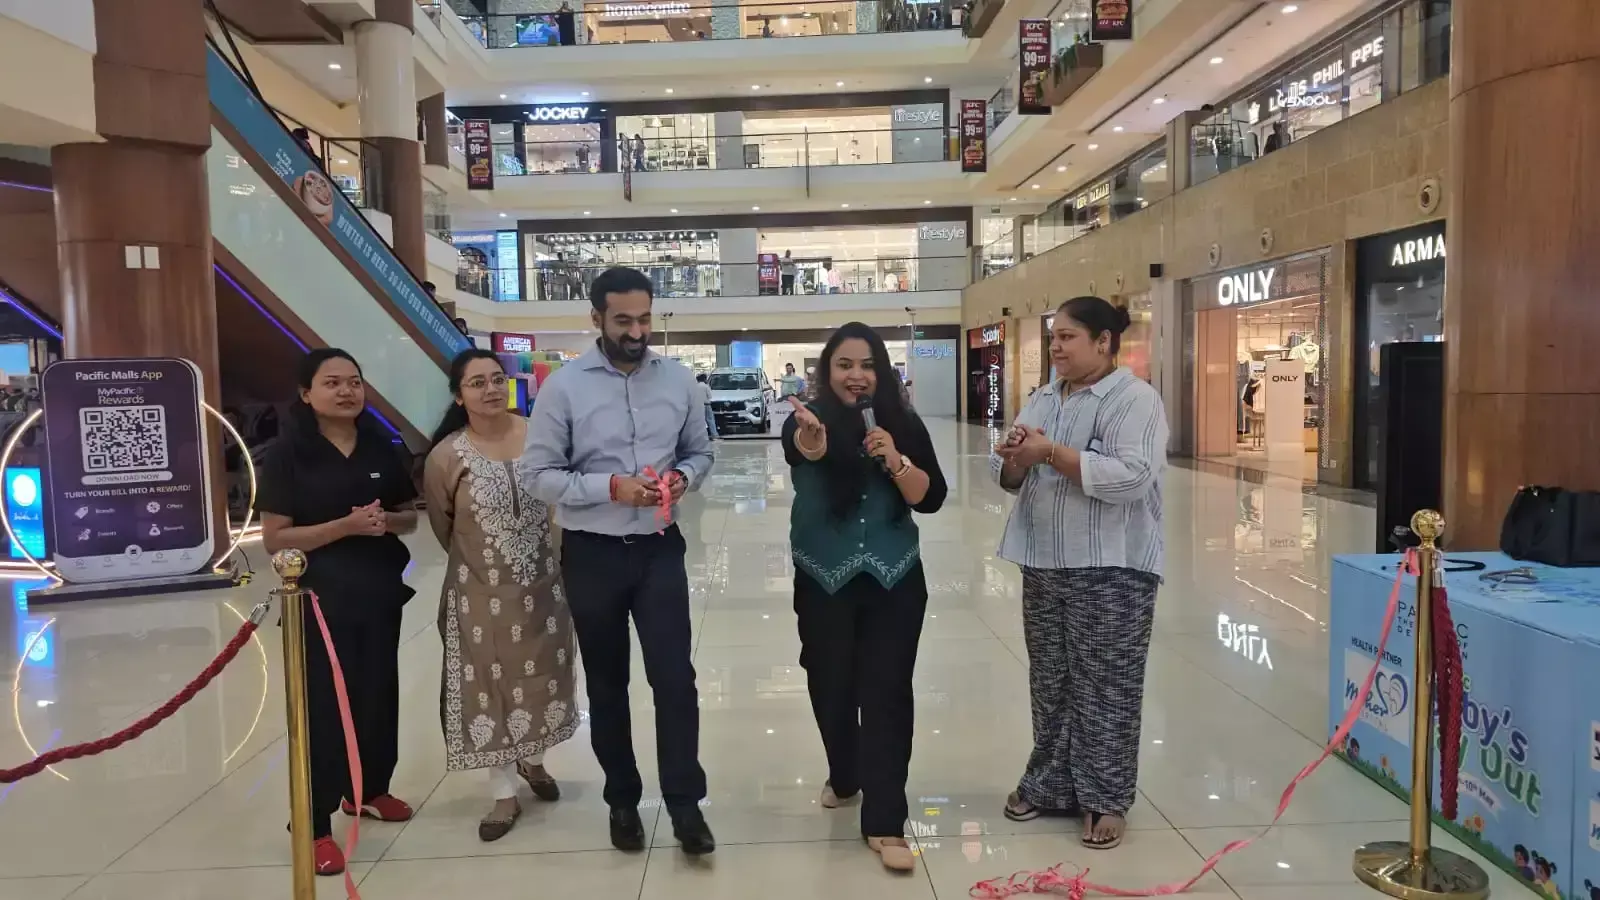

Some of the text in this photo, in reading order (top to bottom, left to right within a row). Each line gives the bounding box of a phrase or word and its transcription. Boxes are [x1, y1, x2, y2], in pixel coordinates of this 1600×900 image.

[528, 106, 589, 121] JOCKEY
[336, 214, 365, 250] WINTER
[1391, 233, 1447, 266] ARMA
[1217, 267, 1275, 306] ONLY
[75, 370, 163, 381] Pacific Malls App
[97, 387, 136, 396] MyPacific
[98, 395, 144, 404] Rewards
[987, 363, 1000, 416] Superdry
[96, 473, 160, 483] DOWNLOAD NOW
[64, 491, 87, 499] TURN
[87, 489, 110, 497] YOUR
[111, 488, 127, 496] BILL
[129, 487, 148, 495] INTO
[156, 484, 191, 493] REWARD!
[1397, 616, 1413, 629] THE
[1351, 635, 1402, 667] HEALTH PRTNER
[1461, 690, 1529, 764] by's
[1480, 739, 1541, 815] Out
